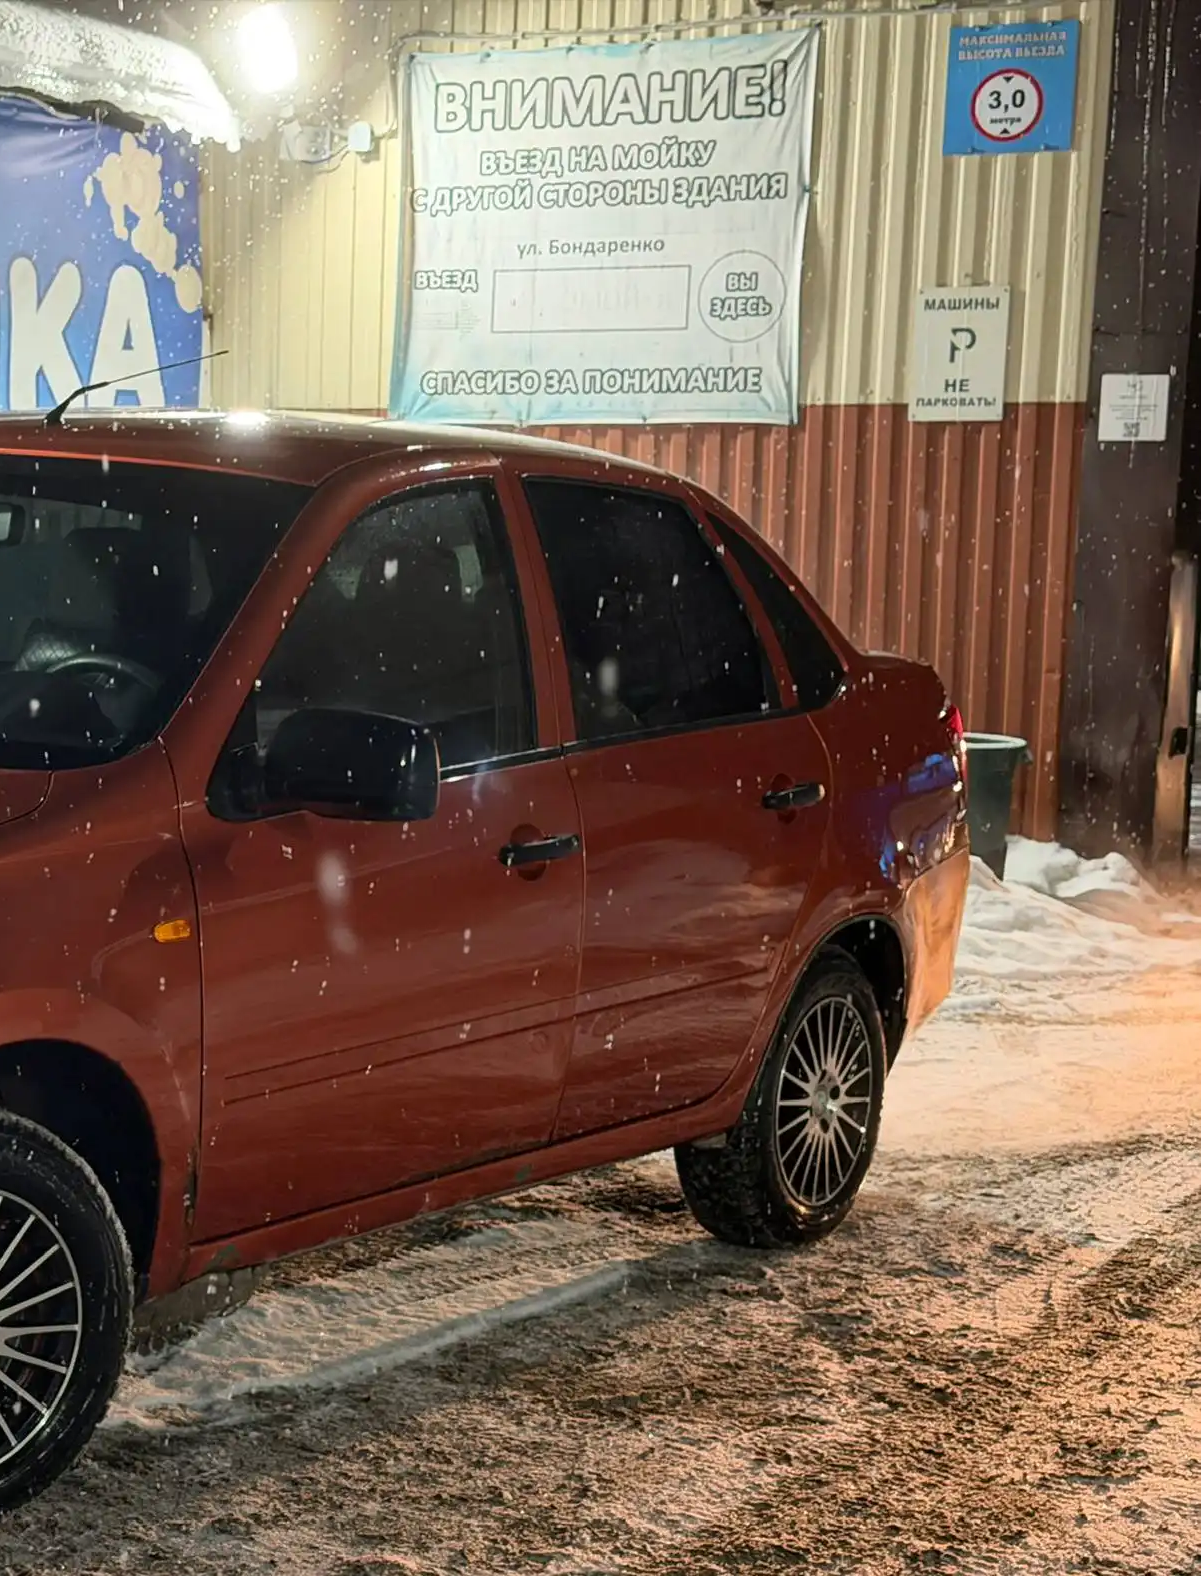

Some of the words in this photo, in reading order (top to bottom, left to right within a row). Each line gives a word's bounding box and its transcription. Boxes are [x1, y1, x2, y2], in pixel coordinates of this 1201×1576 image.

[959, 31, 1067, 47] МАКСИМАЛЬНАЯ
[958, 48, 1012, 61] ВЫСОТА
[434, 59, 788, 133] ВНИМАНИЕ!
[988, 89, 1026, 113] 3,0
[480, 146, 563, 177] ВЪЕЗД
[568, 145, 607, 174] НА
[612, 136, 716, 171] МОЙКУ
[411, 188, 429, 213] С
[430, 179, 533, 217] ДРУГОЙ
[538, 179, 667, 210] СТОРОНЫ
[672, 173, 788, 208] ЗДАНИЯ
[517, 240, 543, 259] ул.
[549, 238, 665, 256] Бондаренко
[414, 268, 478, 292] ВЪЕЗД
[726, 271, 758, 293] ВЫ
[709, 296, 773, 320] ЗДЕСЬ
[924, 297, 1000, 312] МАШИНЫ
[420, 369, 541, 396] СПАСИБО
[544, 369, 579, 395] ЗА
[582, 367, 763, 395] ПОНИМАНИЕ
[944, 378, 970, 393] НЕ
